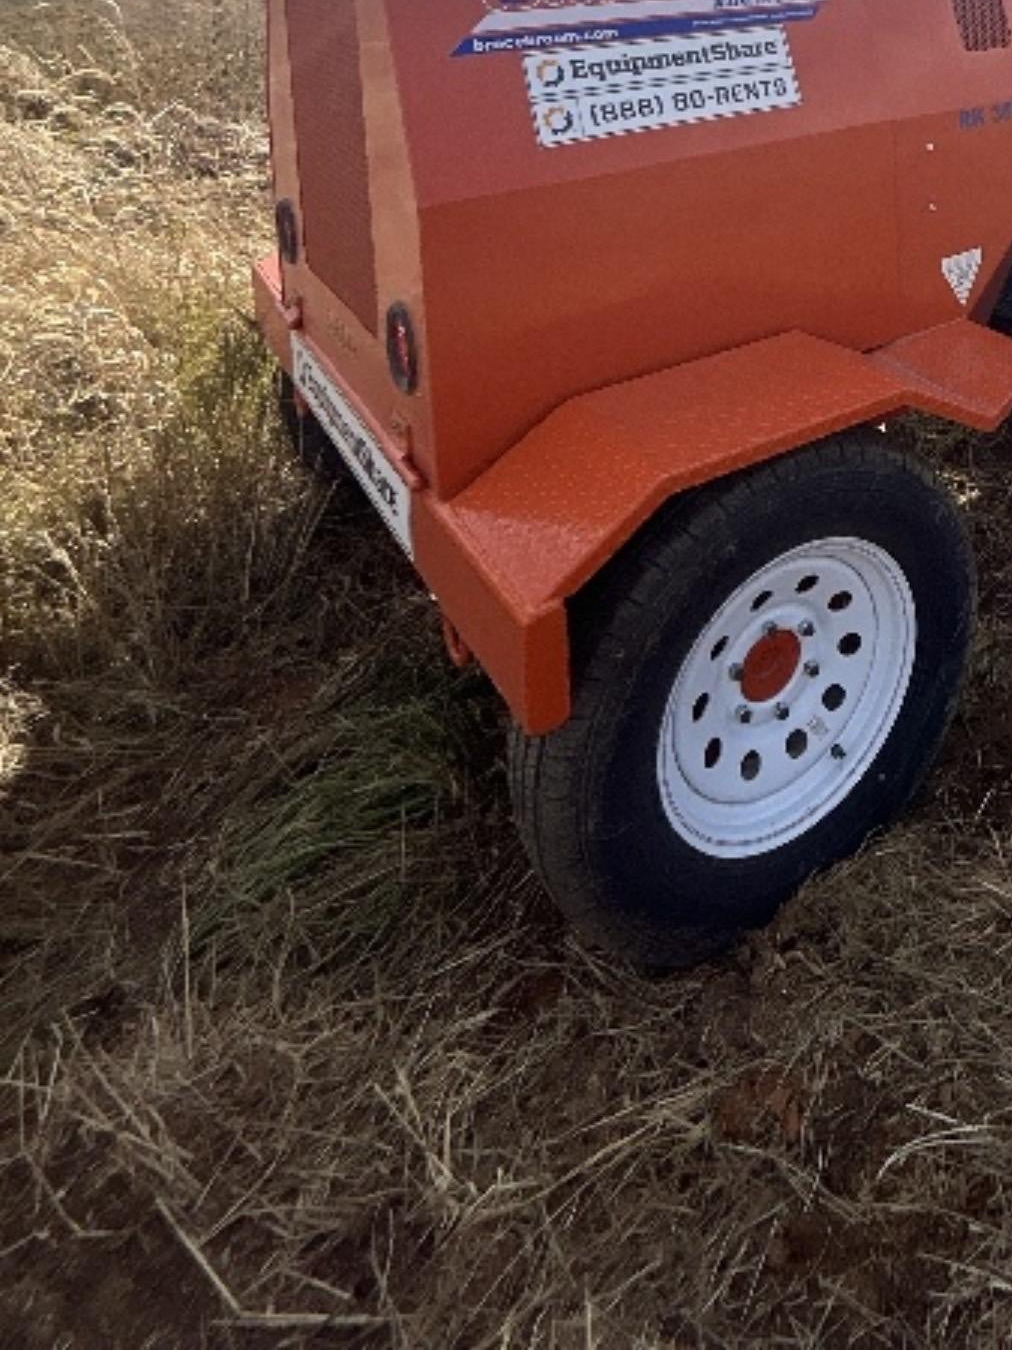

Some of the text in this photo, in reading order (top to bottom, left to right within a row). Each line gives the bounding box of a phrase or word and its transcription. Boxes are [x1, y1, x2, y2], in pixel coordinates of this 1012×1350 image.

[569, 41, 778, 81] EquipmentShare
[590, 77, 788, 127] (888) 80-RENTS
